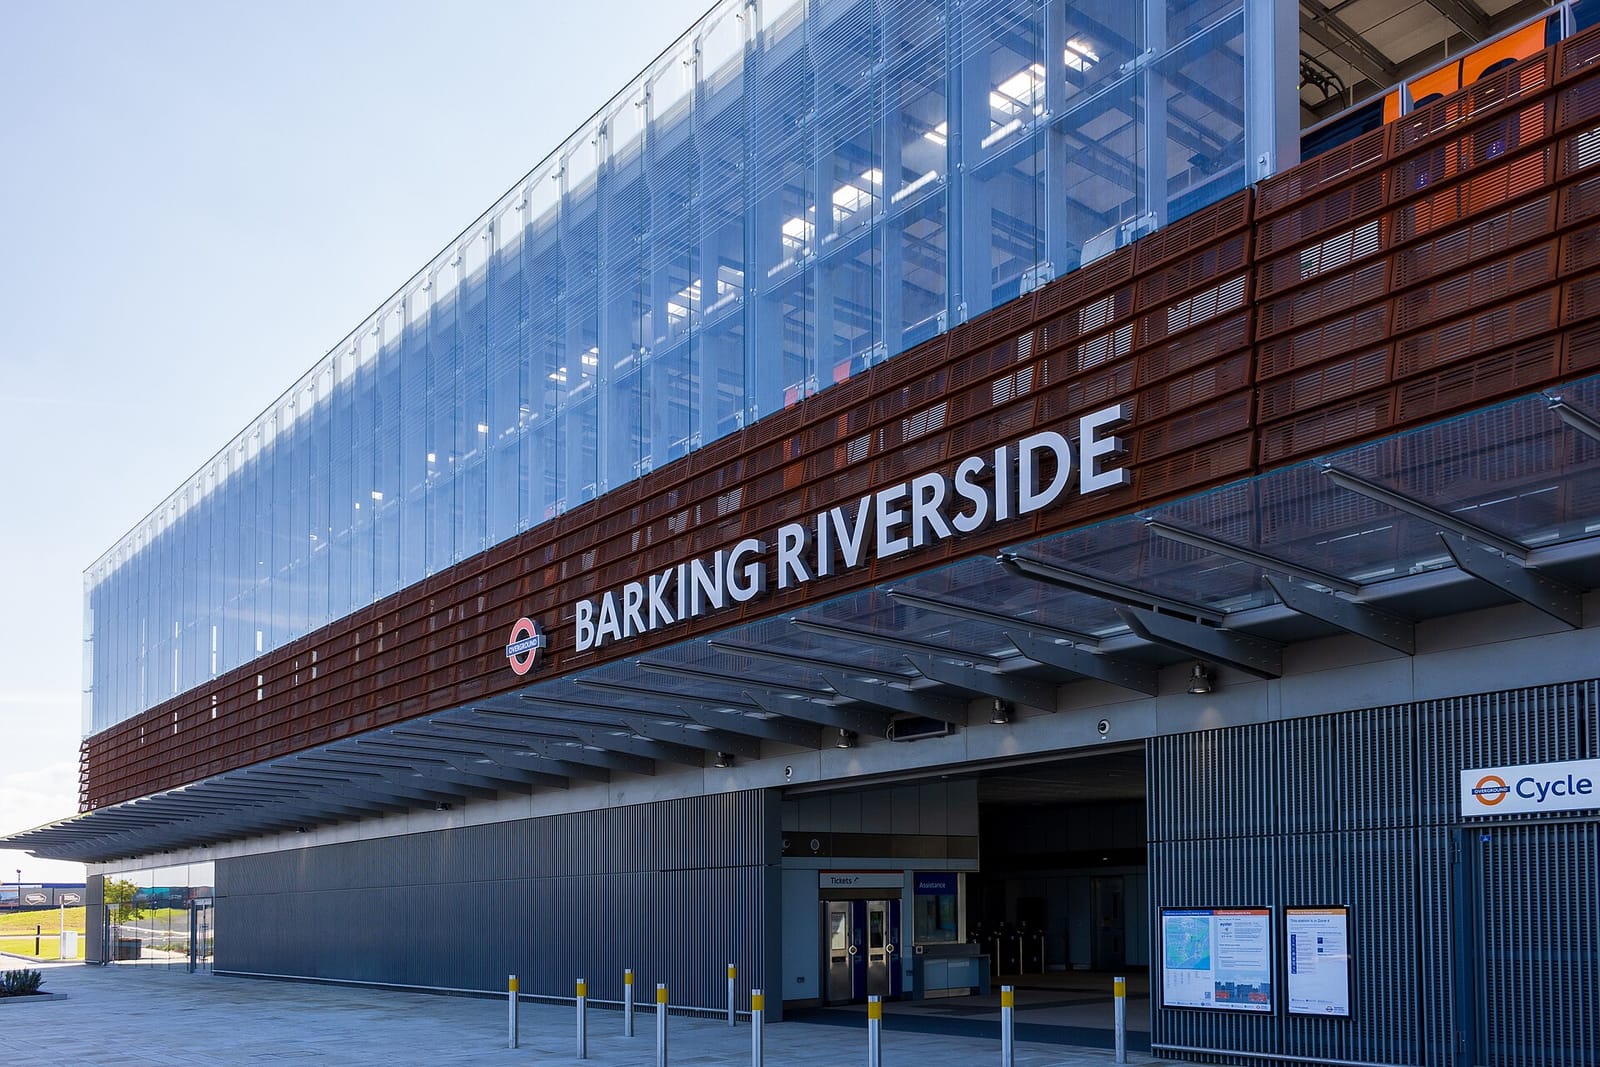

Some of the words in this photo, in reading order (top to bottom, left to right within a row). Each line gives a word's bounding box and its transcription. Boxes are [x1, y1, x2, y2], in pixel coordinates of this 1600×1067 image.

[575, 538, 766, 653] BARKING
[777, 404, 1131, 590] RIVERSIDE
[508, 638, 538, 654] OVERGROUND
[1516, 774, 1593, 803] Cycle
[830, 876, 853, 885] Tickets
[919, 881, 946, 889] Assistance
